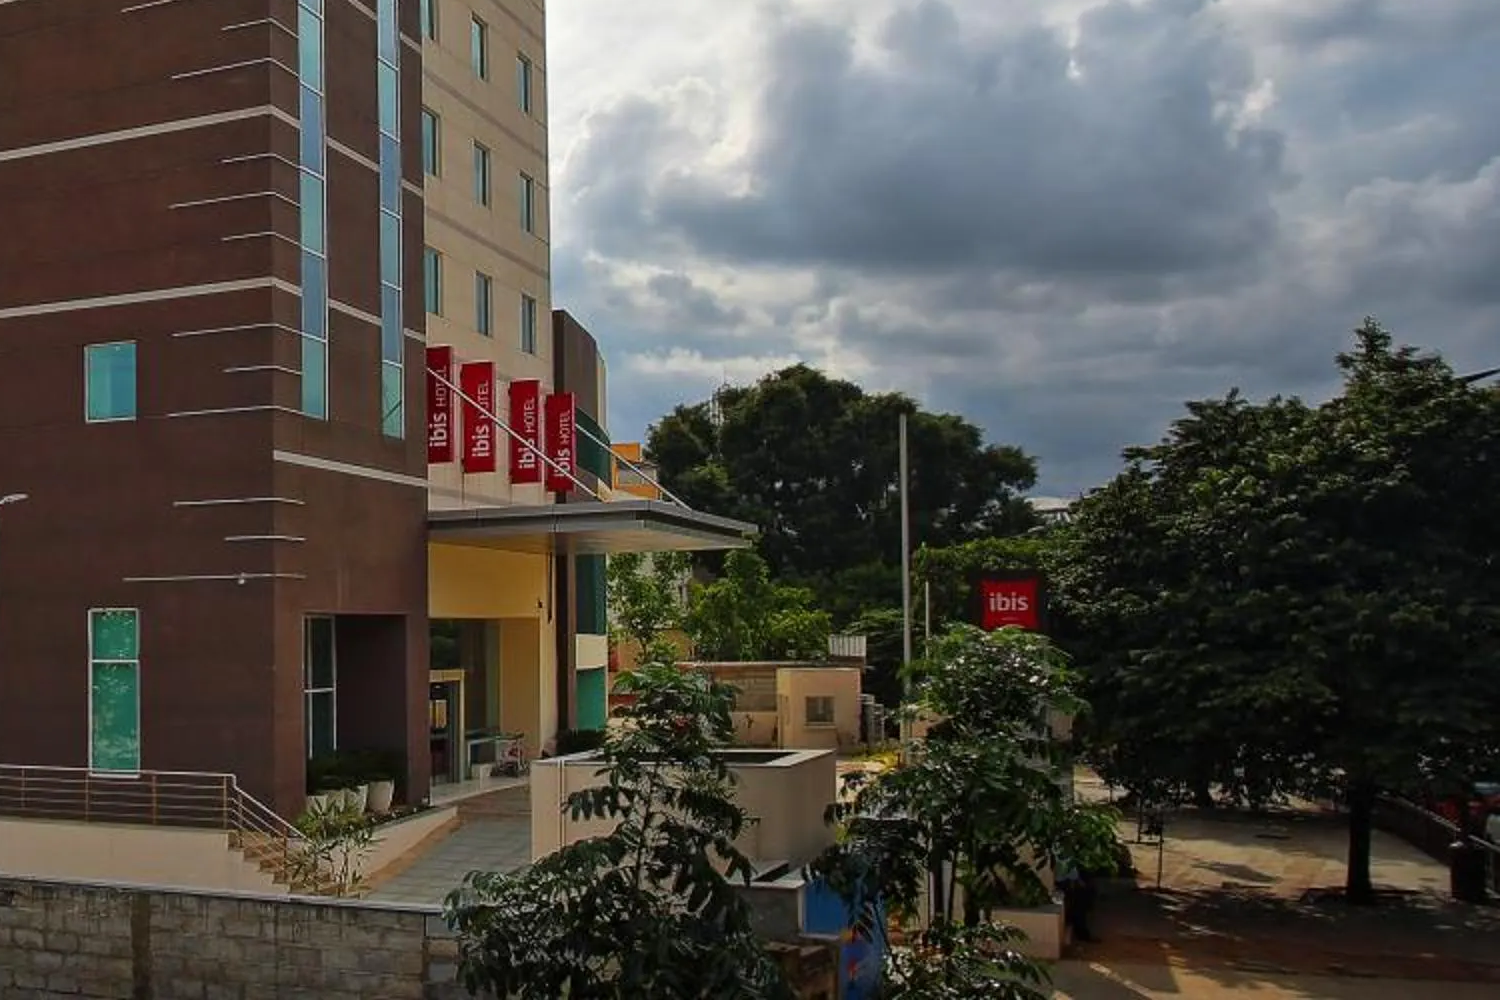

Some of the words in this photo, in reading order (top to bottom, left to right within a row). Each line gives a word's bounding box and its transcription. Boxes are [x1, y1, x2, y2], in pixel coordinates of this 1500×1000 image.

[429, 413, 447, 447] ibis
[524, 396, 536, 433] HOTEL
[559, 409, 571, 445] HOTEL
[471, 424, 490, 457] ibis
[989, 592, 1029, 612] ibis
